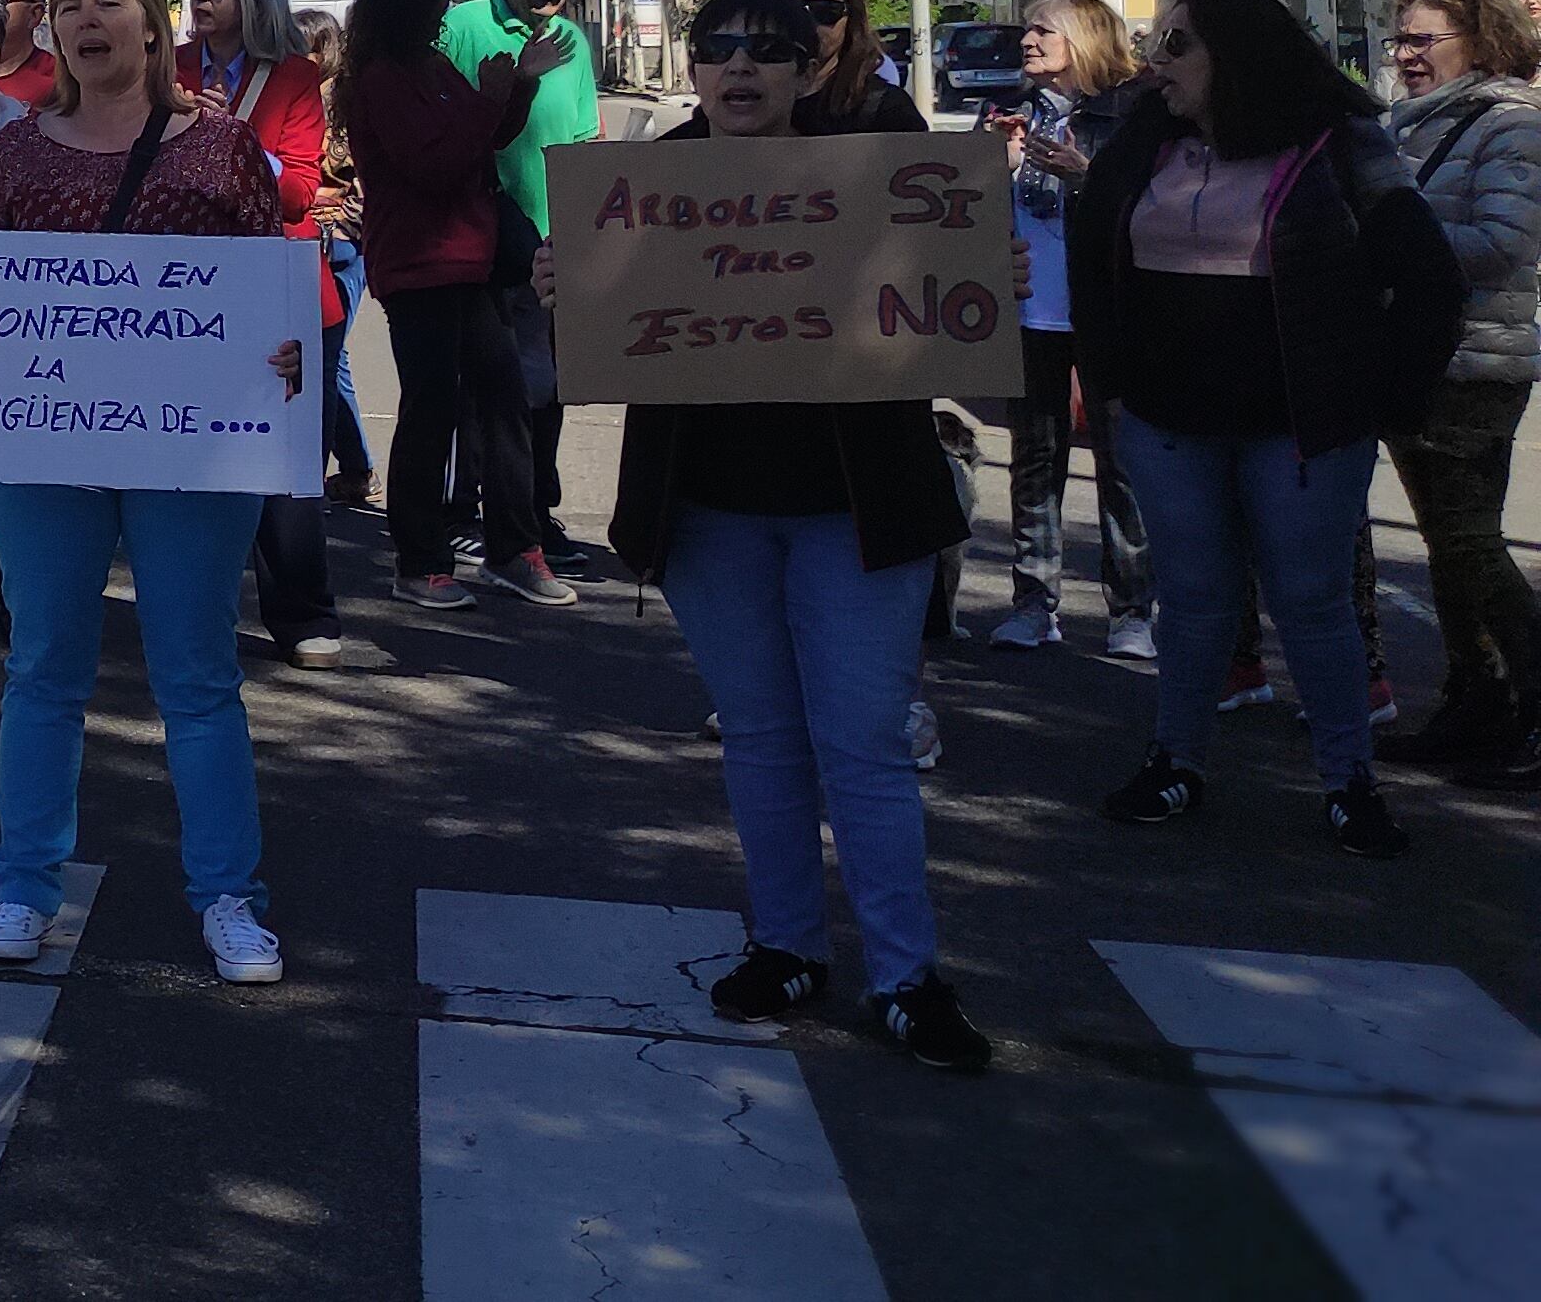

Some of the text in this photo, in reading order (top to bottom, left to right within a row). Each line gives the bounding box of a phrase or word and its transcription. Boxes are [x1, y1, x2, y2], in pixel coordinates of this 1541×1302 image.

[594, 162, 984, 231] ARBOLES SI
[158, 261, 218, 288] EN
[702, 244, 815, 279] PERO
[623, 274, 999, 357] ESTOS NO
[23, 355, 66, 384] LA
